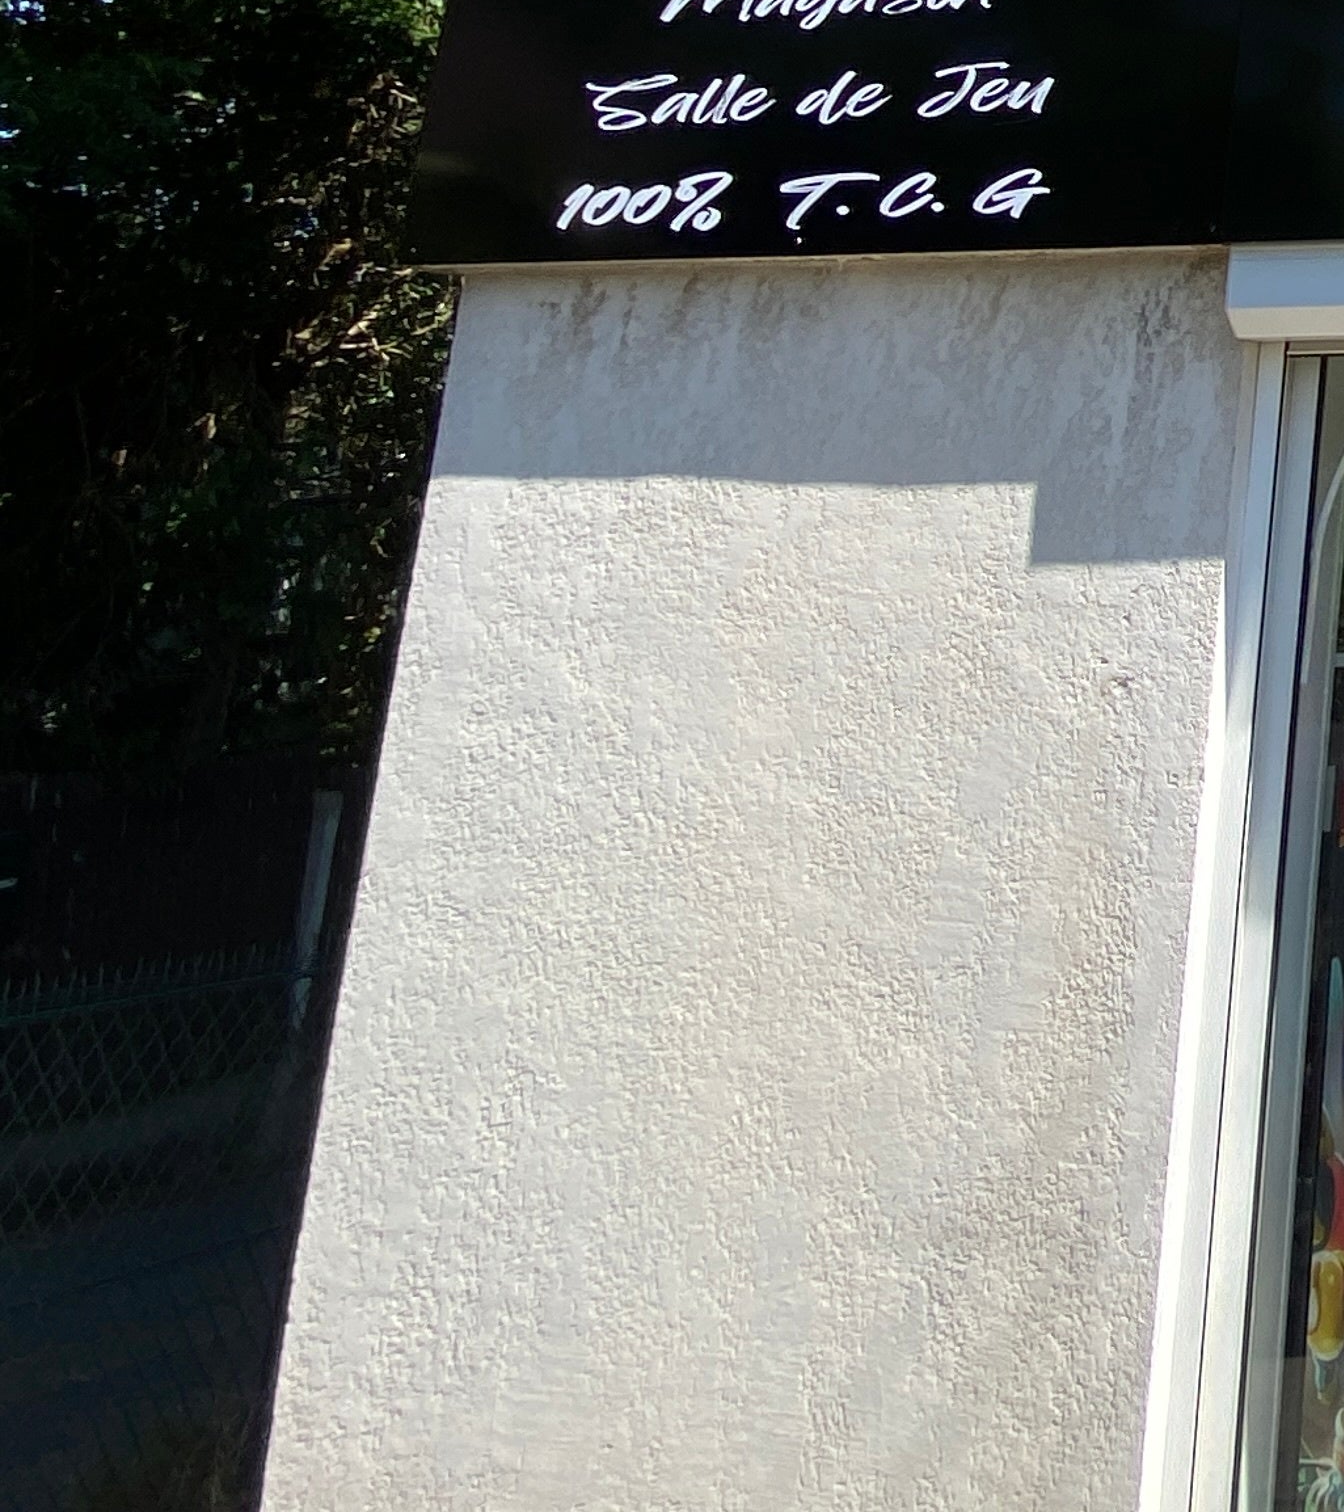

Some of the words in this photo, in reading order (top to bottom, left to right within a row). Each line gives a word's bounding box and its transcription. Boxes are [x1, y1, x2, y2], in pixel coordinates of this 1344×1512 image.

[585, 73, 776, 131] Salle
[796, 69, 892, 126] de
[918, 61, 1056, 119] Jeu
[556, 171, 733, 233] 100%
